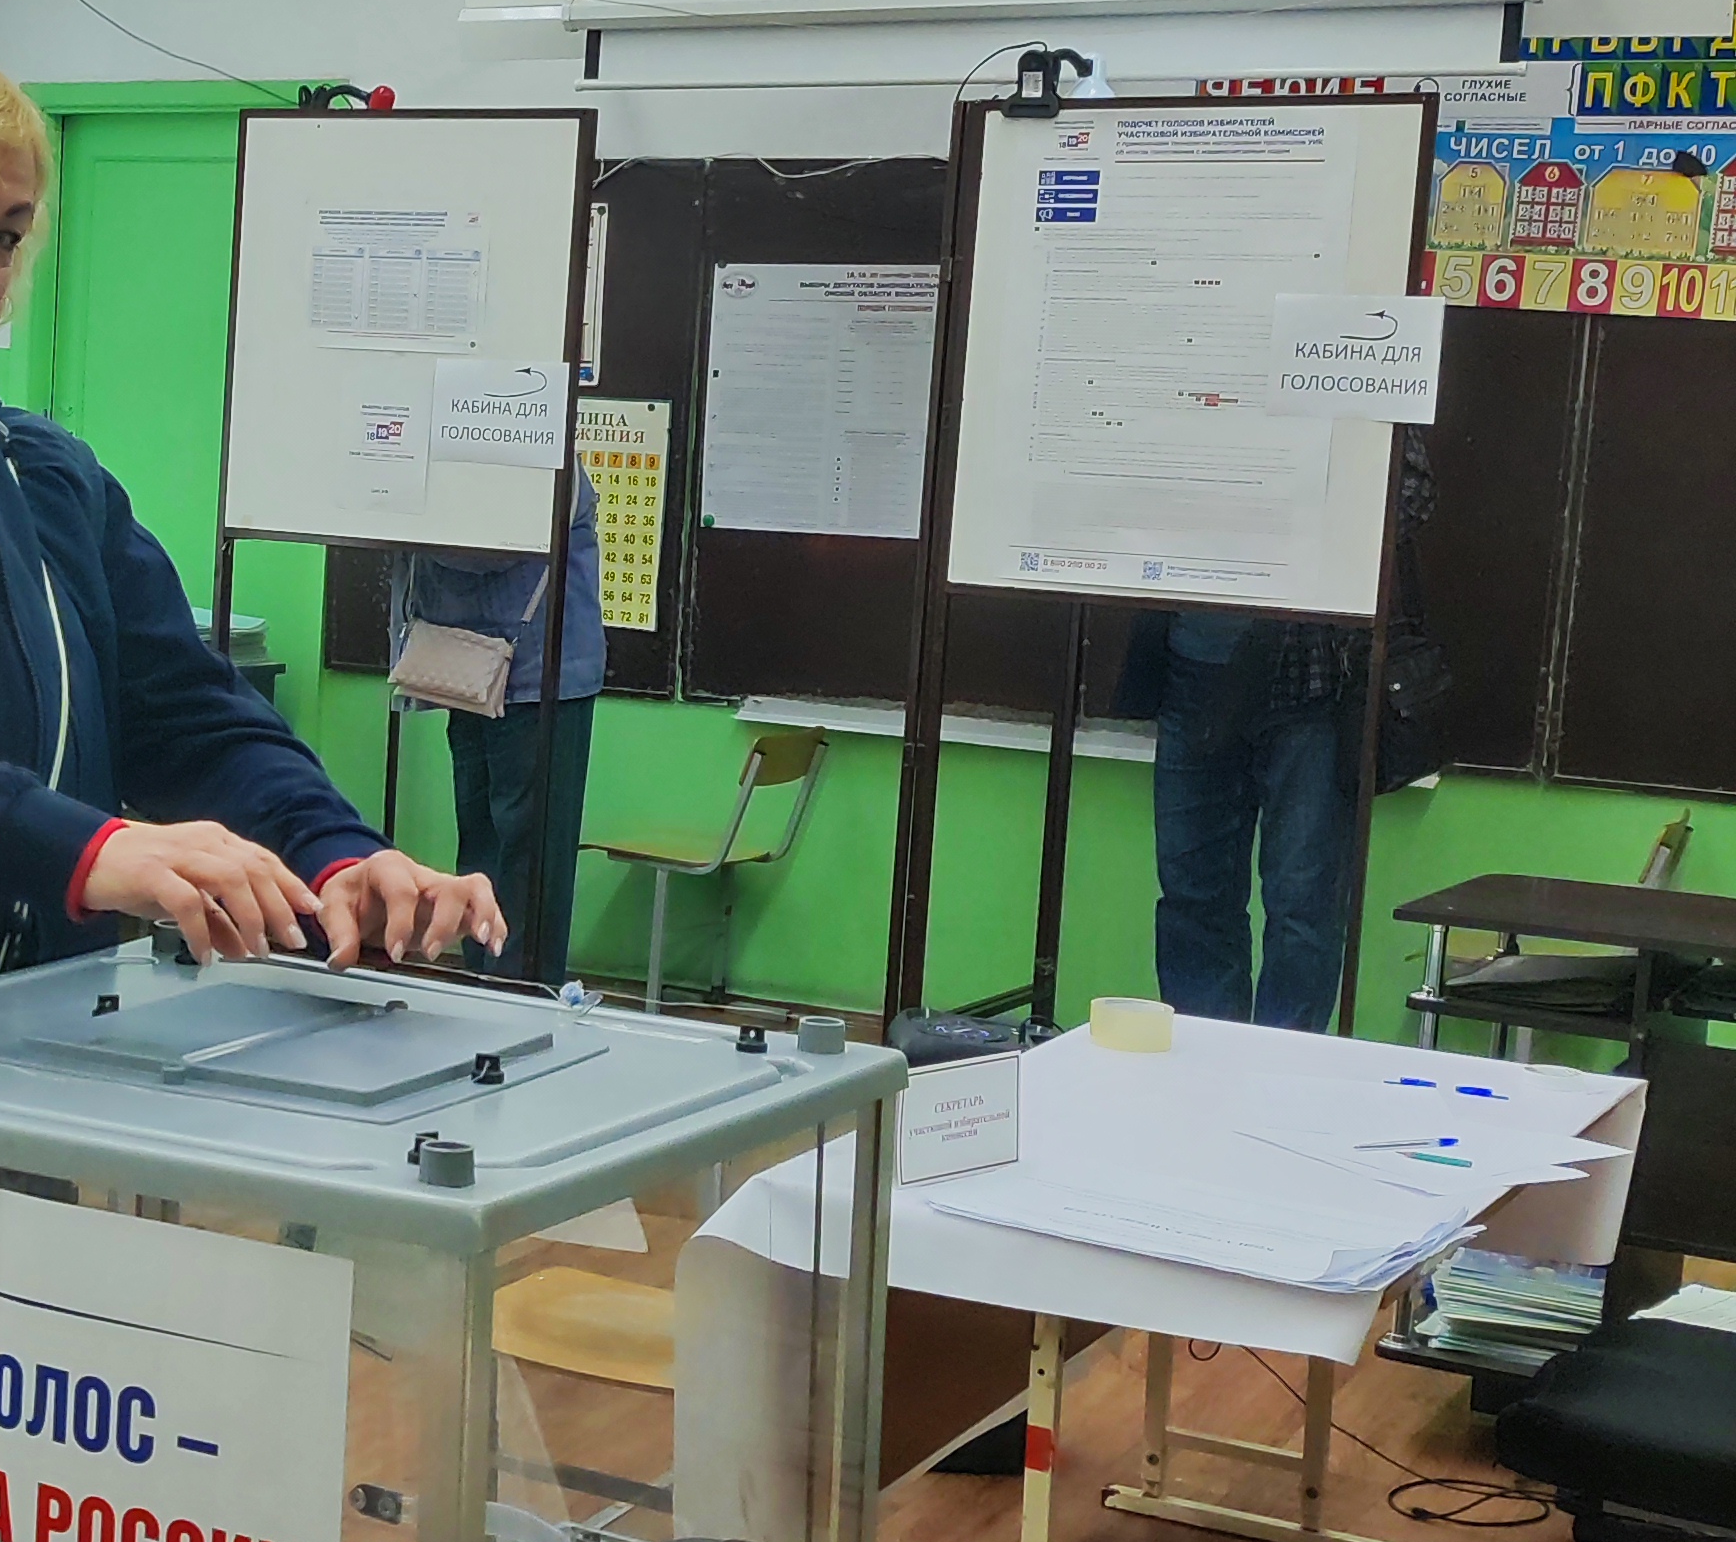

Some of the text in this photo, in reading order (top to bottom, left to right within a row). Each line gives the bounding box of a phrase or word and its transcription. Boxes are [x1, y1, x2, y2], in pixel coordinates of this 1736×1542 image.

[1462, 80, 1512, 89] ГЛУХИЕ
[1444, 92, 1527, 102] СОГЛАСНЫЕ
[1628, 120, 1682, 130] ПАРНЫЕ
[1450, 136, 1551, 159] ЧИСЕЛ
[1574, 144, 1604, 160] от
[1614, 140, 1625, 161] 1
[1639, 148, 1676, 167] до
[1471, 168, 1477, 178] 5
[1548, 168, 1556, 179] 6
[1439, 256, 1736, 315] 5 6 7 8 9 10 1
[1294, 342, 1421, 365] КАБИНА ДЛЯ
[1281, 373, 1428, 396] ГОЛОСОВАНИЯ
[451, 398, 548, 419] КАБИНА ДЛЯ
[367, 425, 401, 440] 18 19 20
[441, 425, 554, 445] ГОЛОСОВАНИЯ
[595, 454, 655, 467] 6 7 8 9
[591, 473, 657, 487] 12 14 16 18
[608, 494, 656, 506] 21 24 27
[606, 513, 655, 526] 28 32 36
[605, 532, 654, 545] 35 40 45
[605, 552, 653, 565] 42 48 54
[604, 571, 652, 585] 49 56 63
[604, 590, 651, 604] 56 64 72
[603, 609, 649, 624] 63 72 81
[934, 1095, 984, 1114] СЕКРЕТАРЬ
